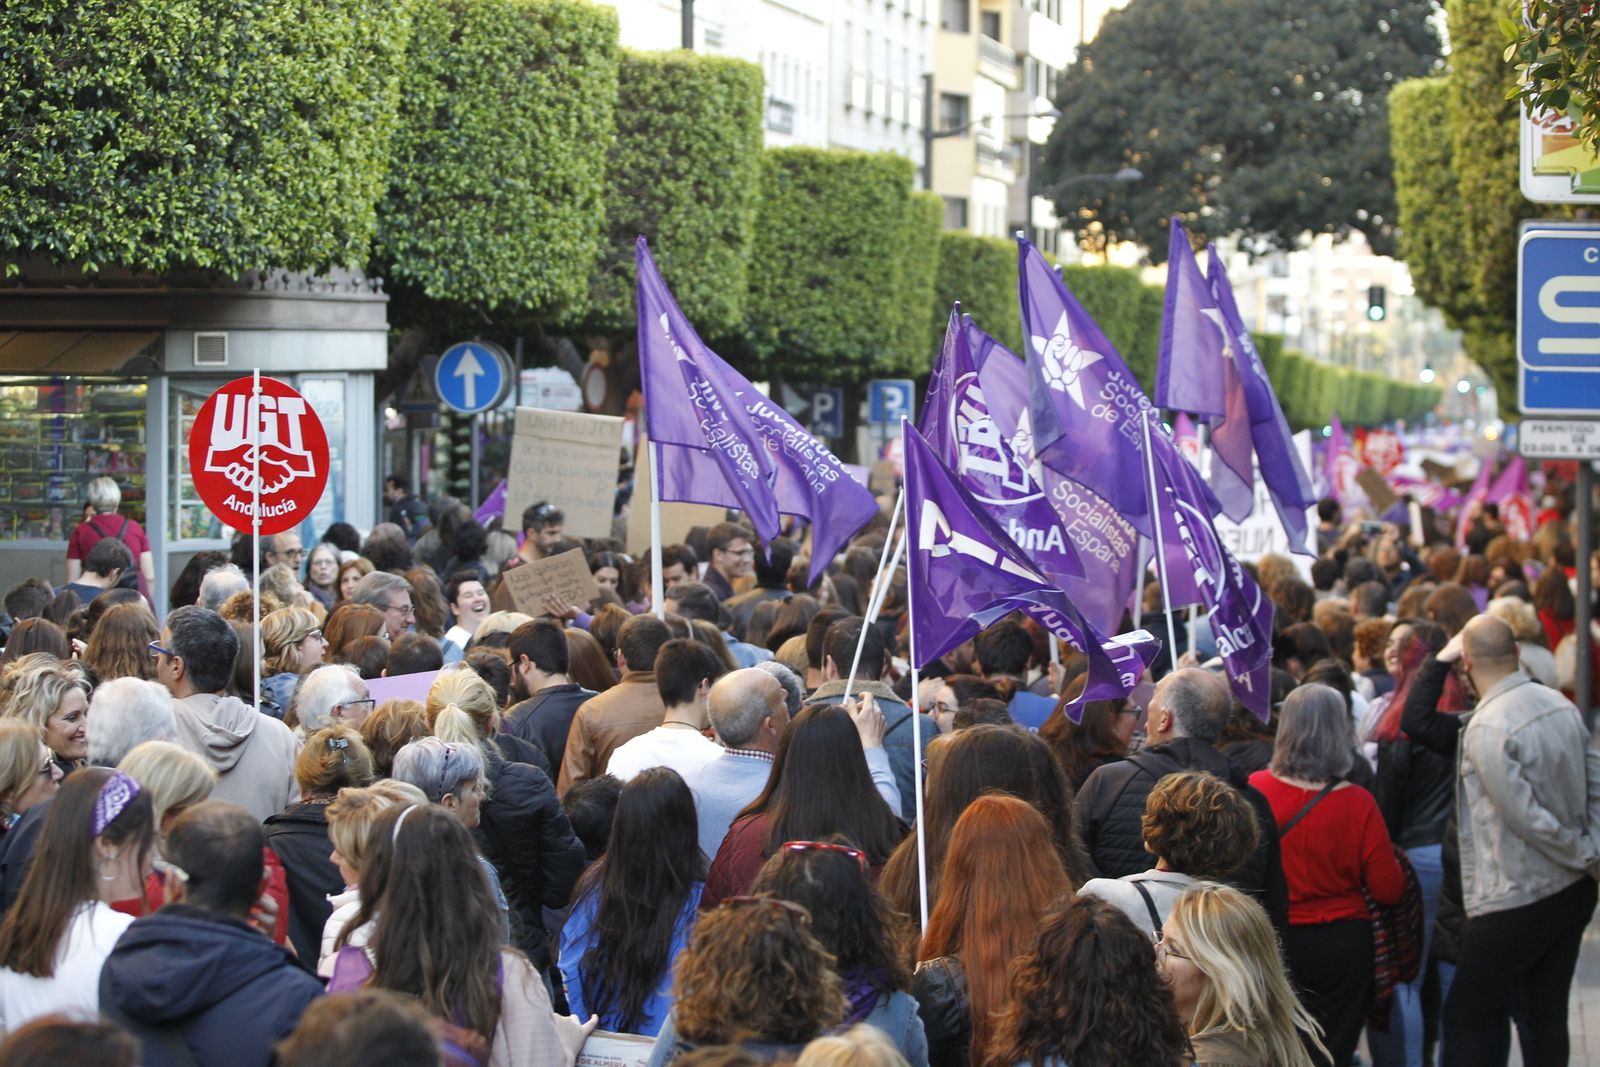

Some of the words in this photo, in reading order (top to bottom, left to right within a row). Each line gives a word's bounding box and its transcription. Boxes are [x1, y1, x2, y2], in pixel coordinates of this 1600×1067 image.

[211, 394, 306, 455] UGT
[812, 393, 834, 421] P
[1091, 403, 1120, 423] de
[1053, 479, 1131, 558] Socialistas
